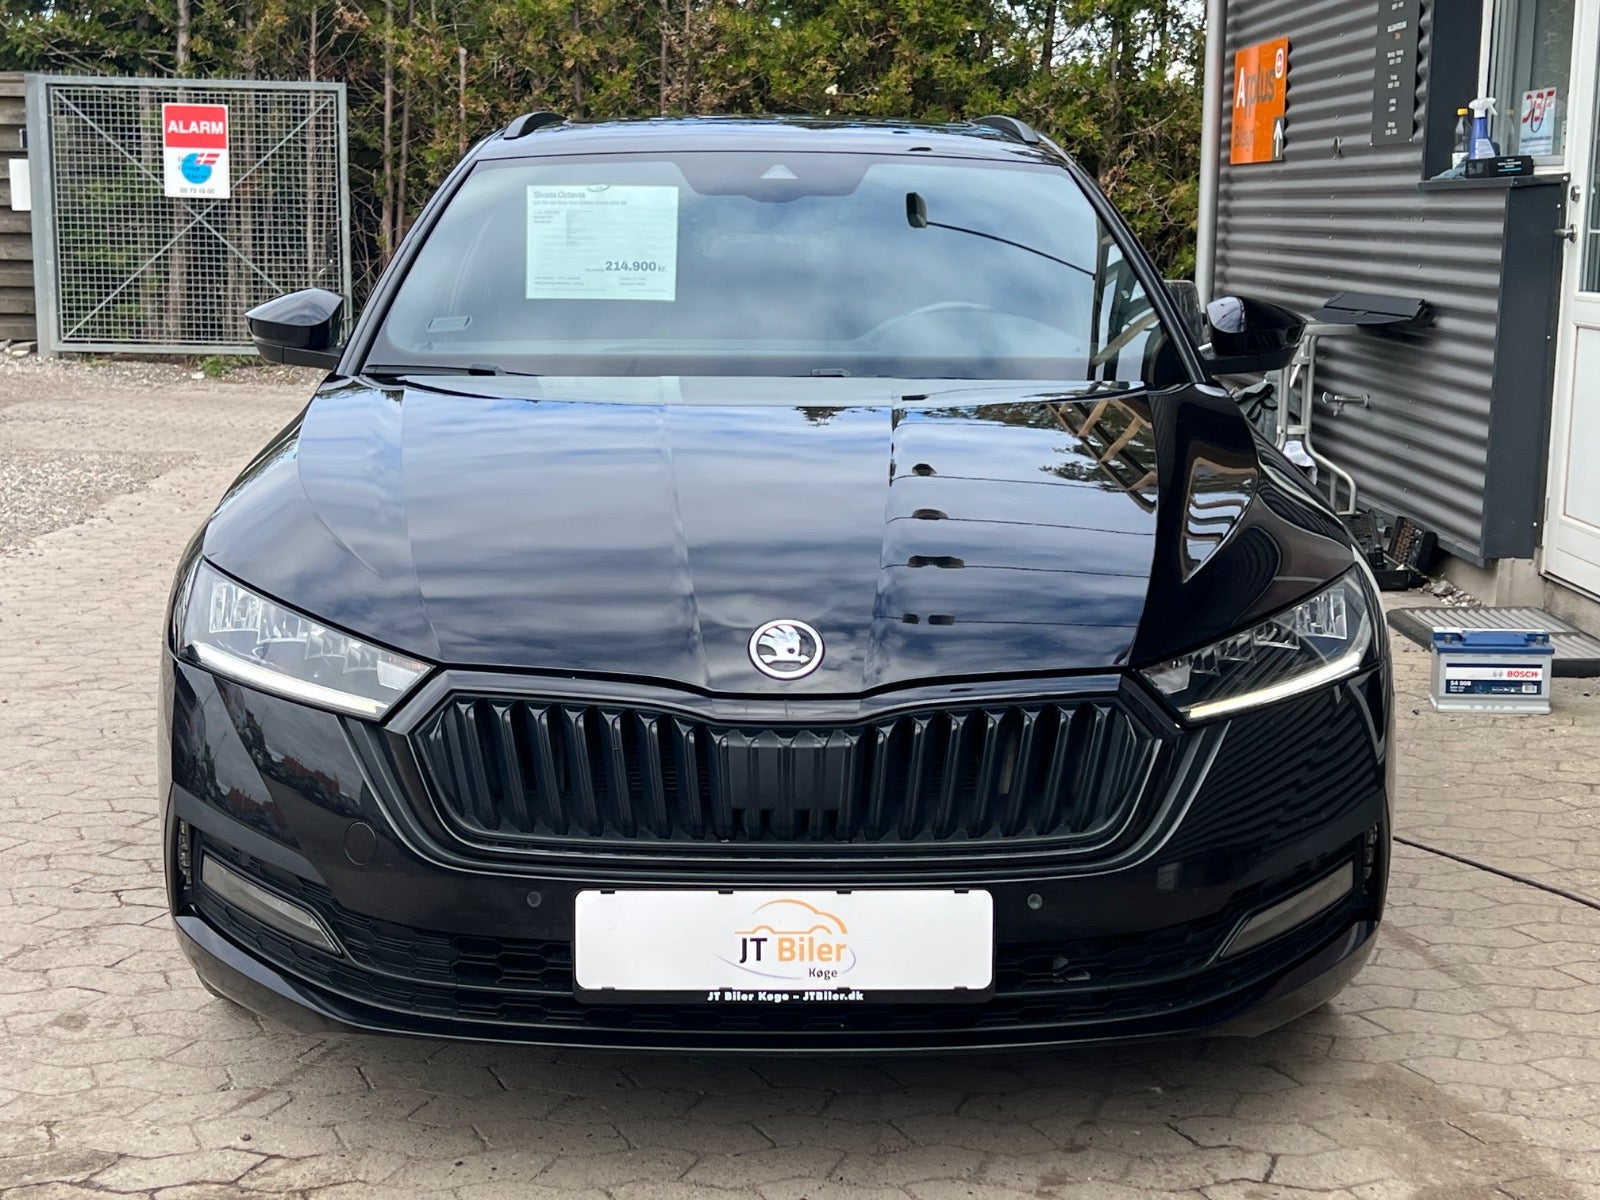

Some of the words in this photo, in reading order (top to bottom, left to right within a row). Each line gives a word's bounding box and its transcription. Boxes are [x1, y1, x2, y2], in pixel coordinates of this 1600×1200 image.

[167, 120, 224, 135] ALARM
[534, 191, 557, 199] Skoda
[558, 191, 586, 199] Octavia
[605, 260, 657, 272] 214.900
[739, 937, 768, 964] JT
[777, 937, 847, 962] Biler
[808, 967, 838, 980] Køge
[707, 991, 721, 1001] JT
[724, 991, 754, 1001] Biler
[802, 991, 864, 1001] JTBiler.dk
